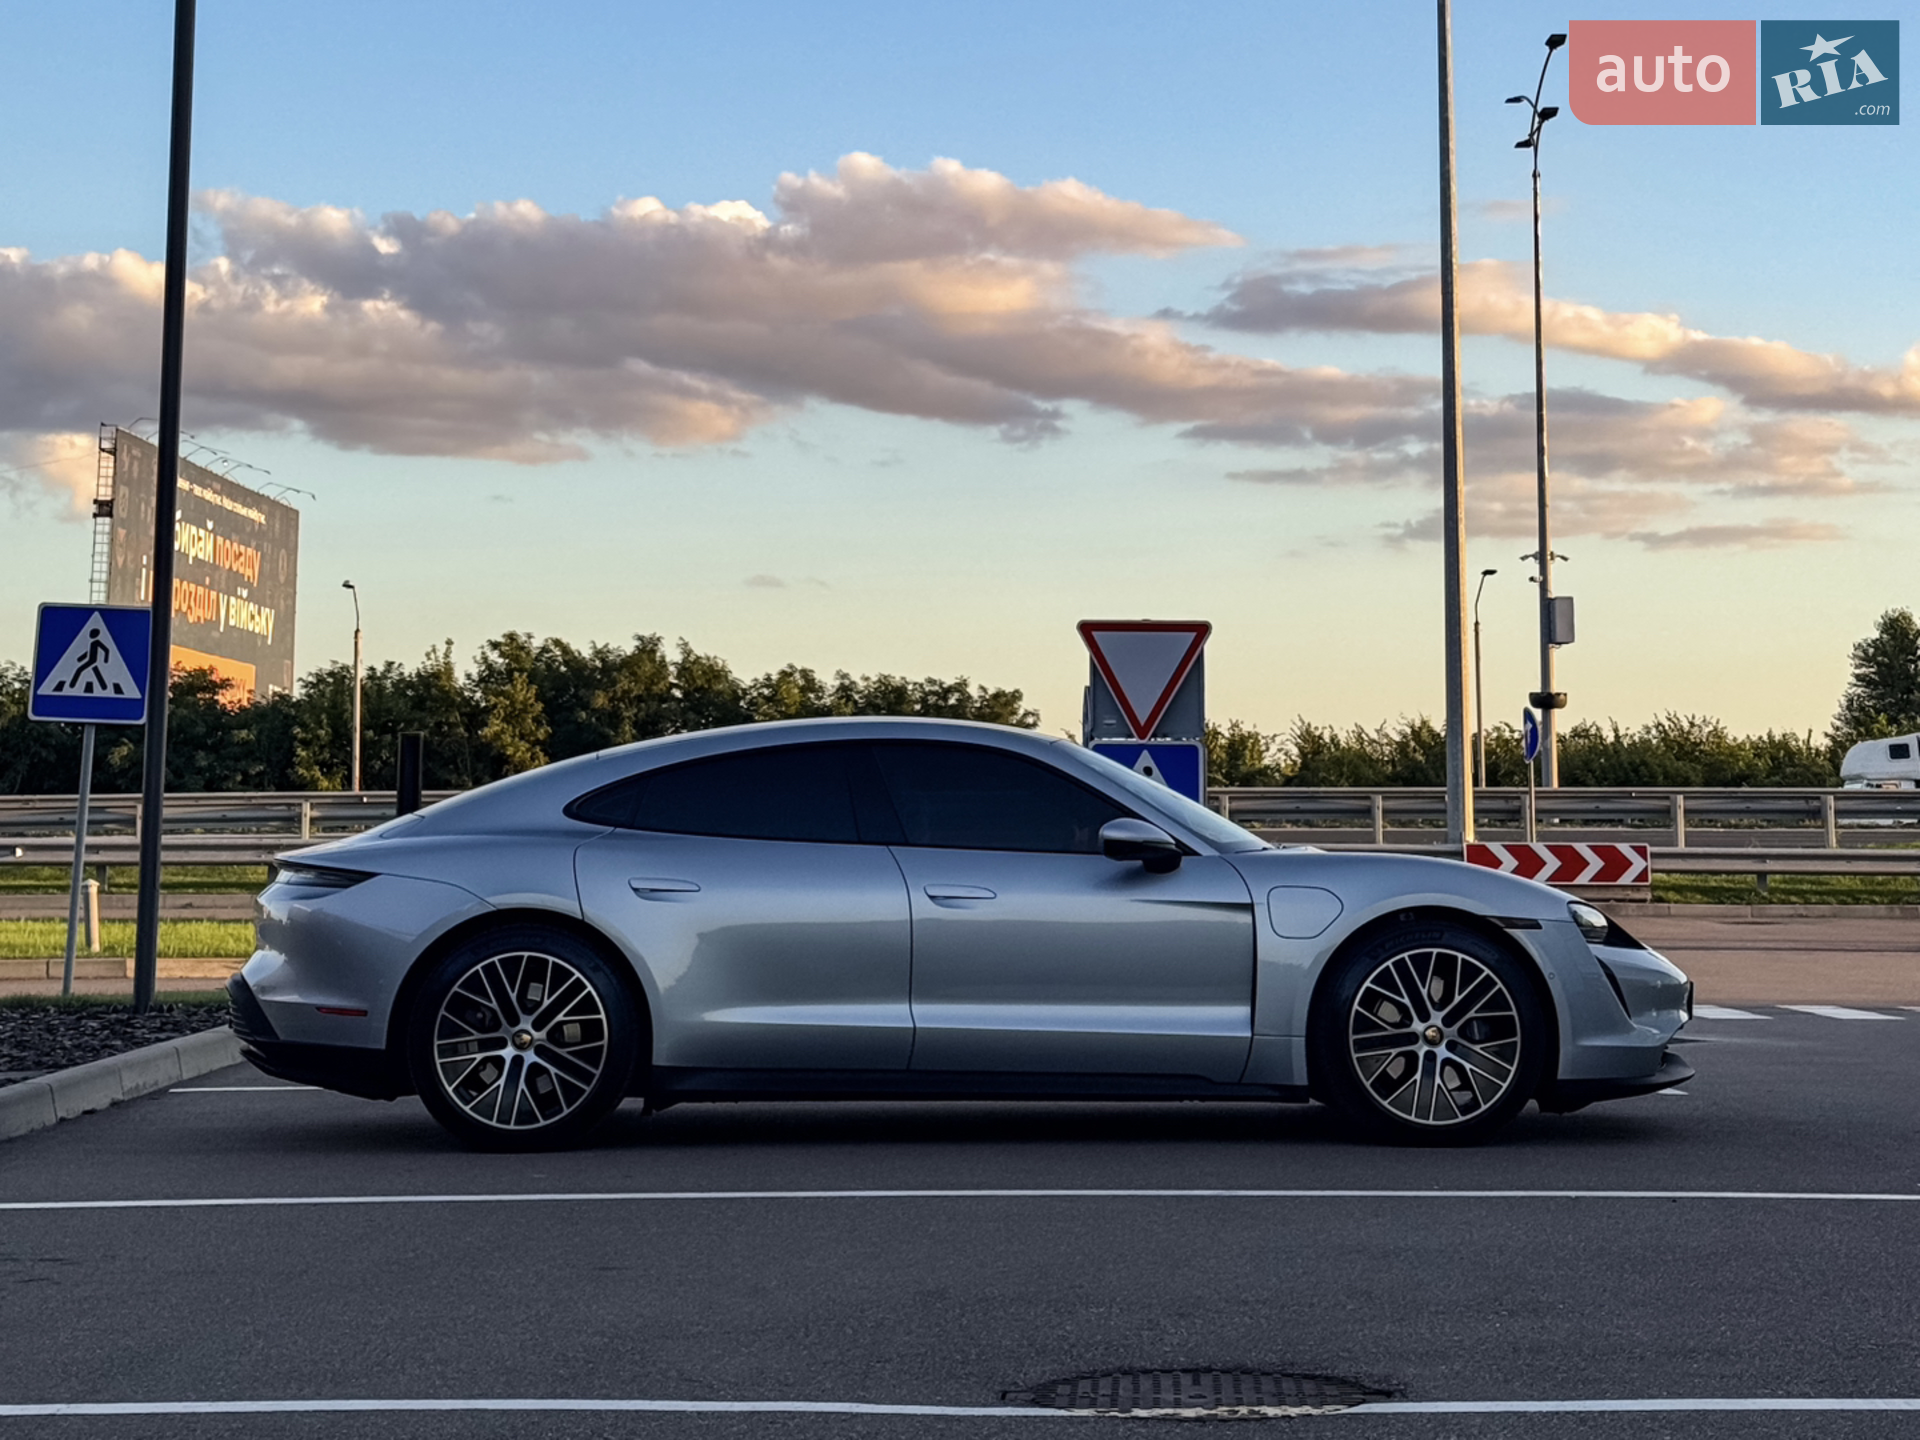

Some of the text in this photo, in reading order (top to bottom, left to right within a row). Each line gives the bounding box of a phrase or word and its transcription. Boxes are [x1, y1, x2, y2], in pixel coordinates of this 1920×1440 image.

[174, 509, 262, 588] бирай посаду
[219, 592, 228, 633] у
[229, 586, 276, 646] війську
